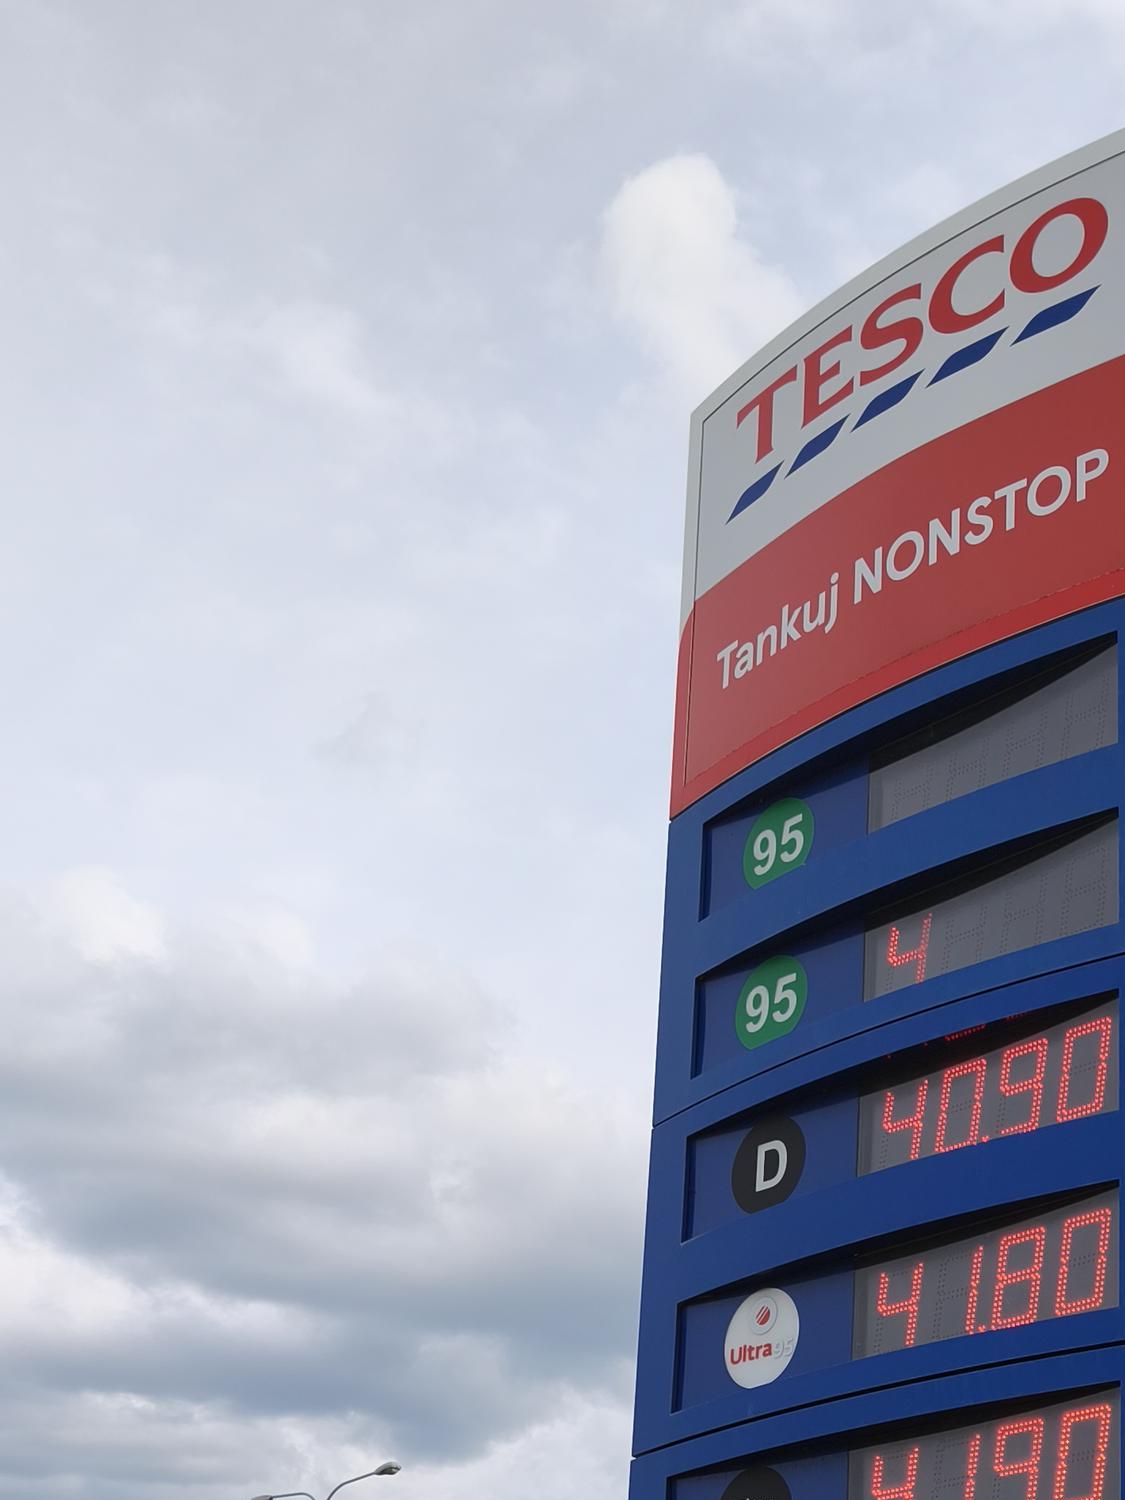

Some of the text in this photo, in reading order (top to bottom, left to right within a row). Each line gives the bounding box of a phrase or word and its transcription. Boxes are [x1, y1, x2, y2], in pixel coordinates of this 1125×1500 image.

[736, 197, 1109, 465] TESCO
[716, 448, 1109, 689] Tankuj NONSTOP
[753, 814, 804, 875] 95
[887, 913, 932, 984] 4
[745, 973, 797, 1033] 95
[882, 1016, 1112, 1160] 40.90
[755, 1140, 788, 1192] D
[877, 1208, 1112, 1346] 41.80
